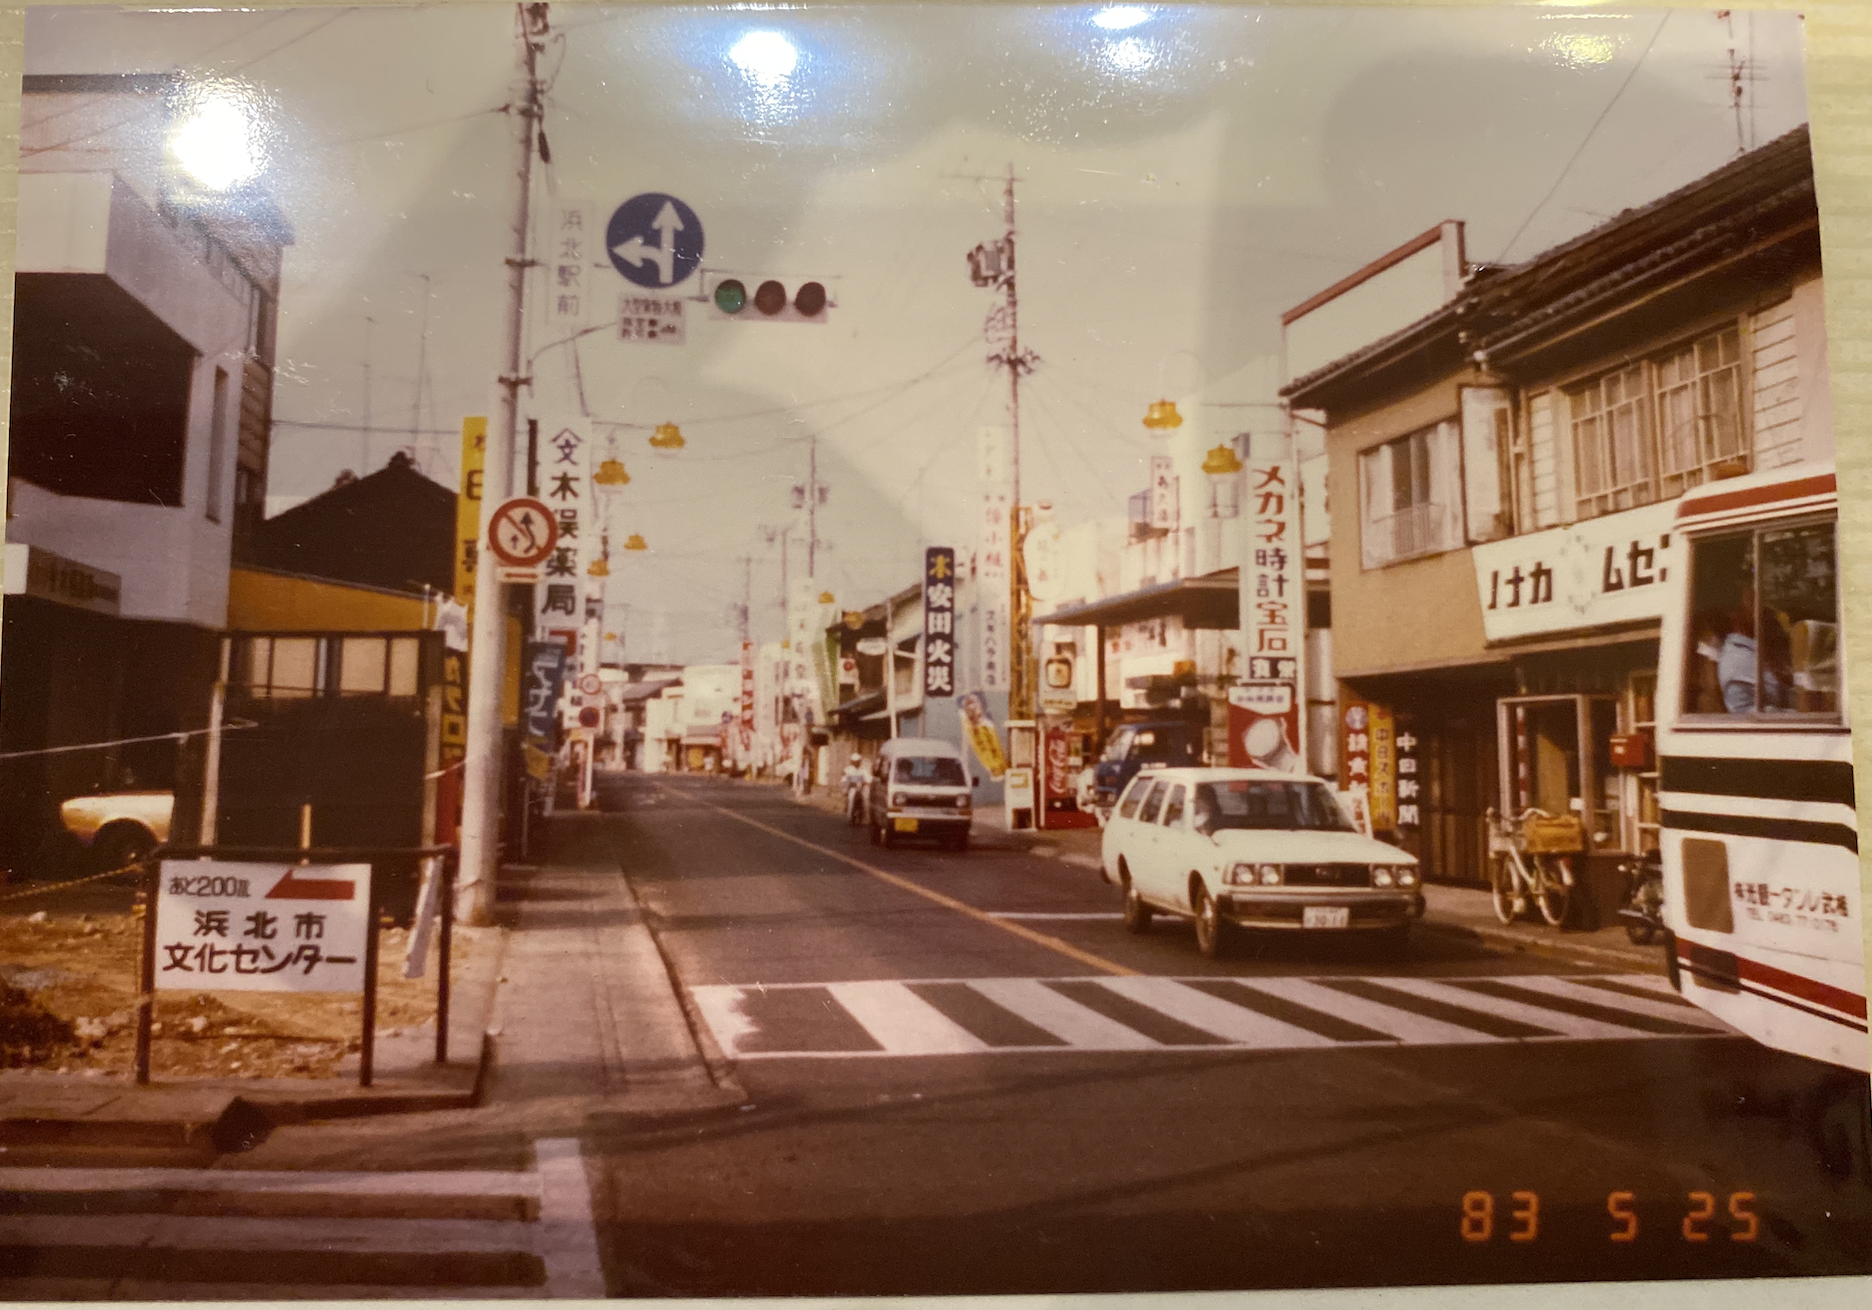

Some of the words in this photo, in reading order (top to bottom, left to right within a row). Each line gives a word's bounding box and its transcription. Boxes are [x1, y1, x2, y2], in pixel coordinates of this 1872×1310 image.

[558, 209, 583, 317] 浜北駅前
[1488, 561, 1553, 610] ノナカ
[927, 582, 952, 693] 安田火災
[1396, 732, 1419, 826] 中日新聞
[162, 941, 358, 975] 文化センター
[194, 909, 328, 941] 浜北市
